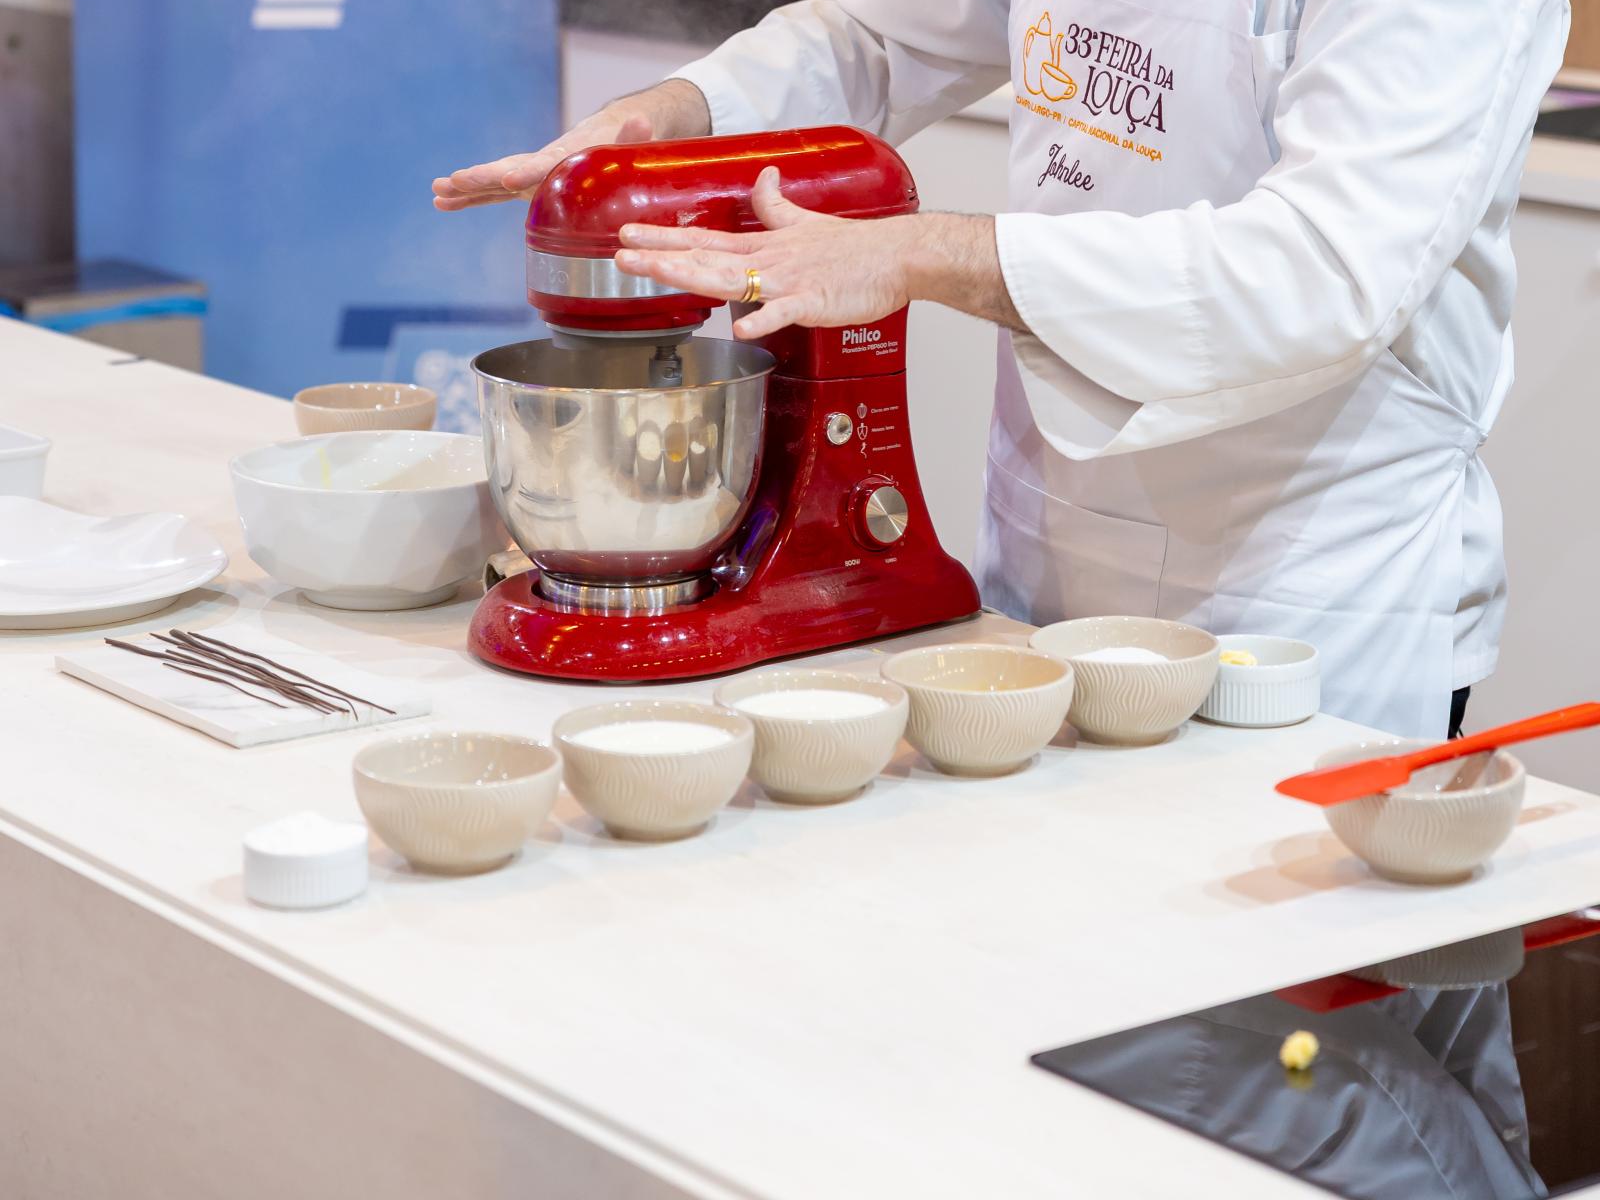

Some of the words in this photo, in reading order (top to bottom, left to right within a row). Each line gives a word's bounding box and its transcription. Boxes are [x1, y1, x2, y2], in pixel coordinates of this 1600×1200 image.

[1094, 31, 1153, 83] FEIRA
[1154, 64, 1175, 91] DA
[1081, 65, 1167, 135] LOUÇA
[1122, 139, 1134, 151] DA
[1136, 143, 1163, 162] LOUÇA
[842, 327, 881, 346] Philco
